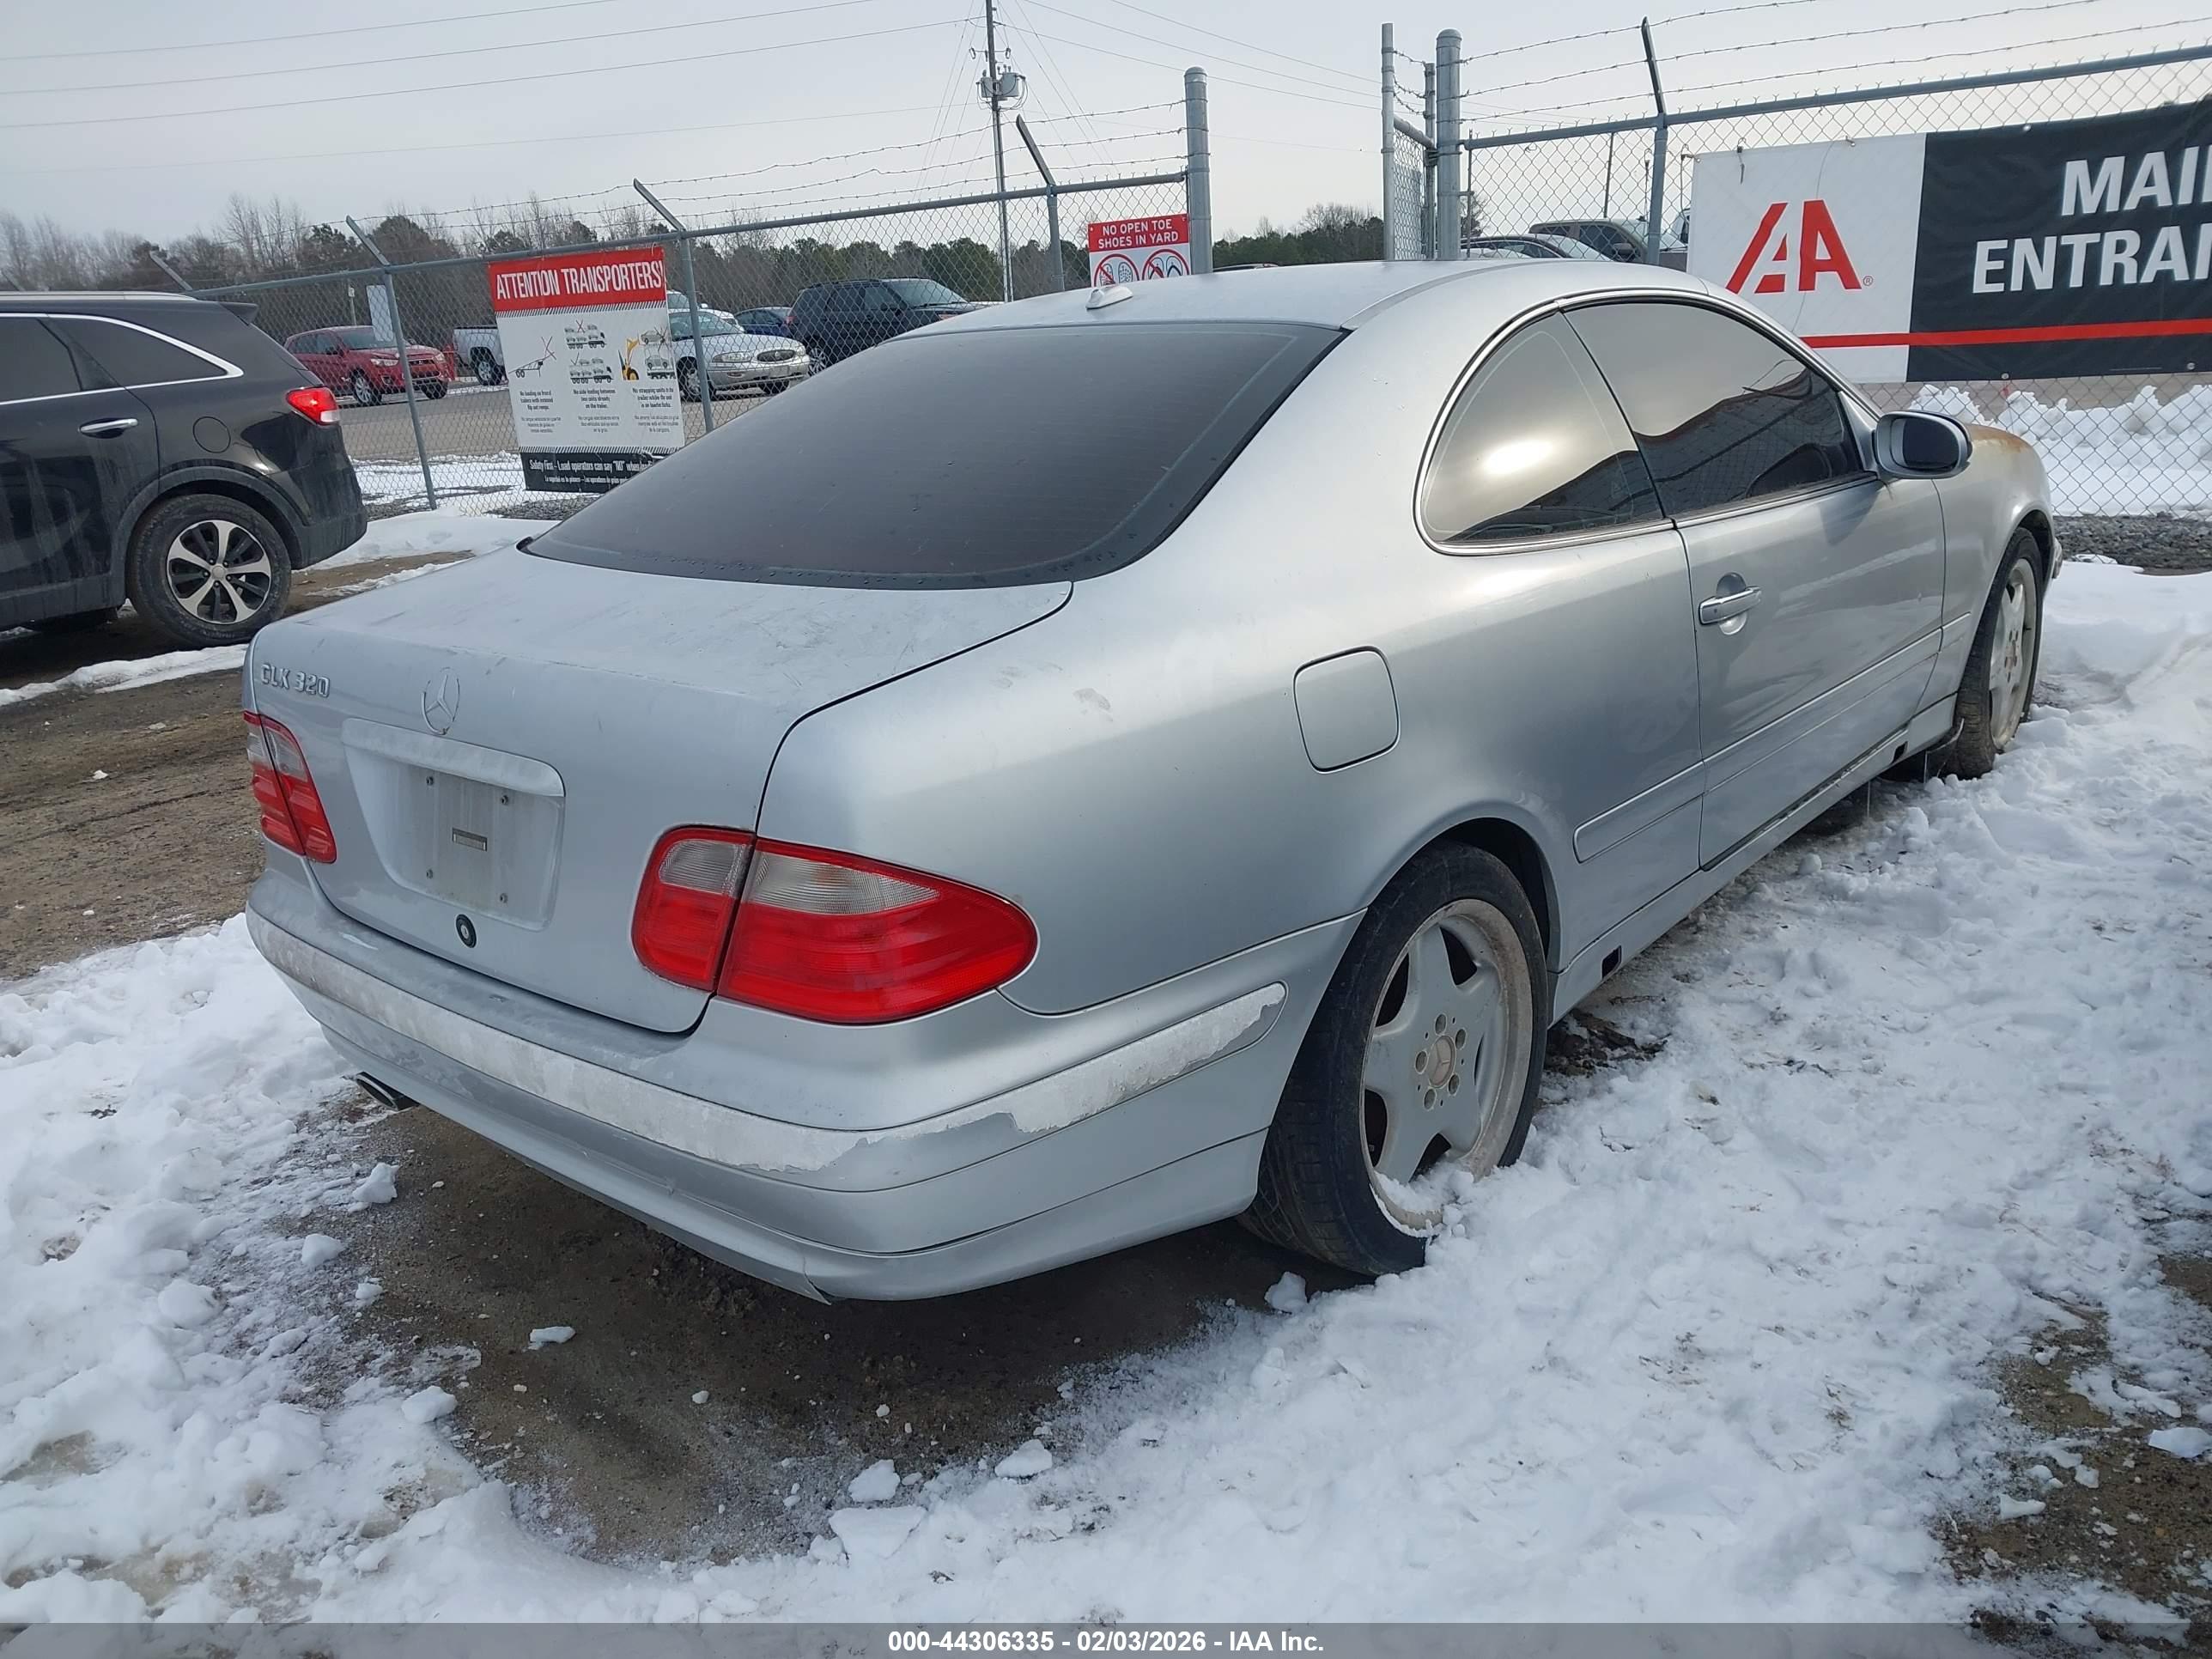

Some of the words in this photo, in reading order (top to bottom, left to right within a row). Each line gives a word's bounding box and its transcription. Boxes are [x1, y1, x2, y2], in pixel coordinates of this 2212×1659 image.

[2062, 144, 2212, 216] MAI
[1098, 236, 1133, 249] SHOES
[1135, 234, 1146, 245] IN
[1150, 231, 1179, 244] YARD
[1103, 225, 1117, 235] NO
[1120, 222, 1148, 234] OPEN
[1152, 219, 1172, 230] TOE
[496, 270, 560, 300] ATTENTION
[561, 260, 664, 295] TRANSPORTERS!
[261, 663, 289, 690] CLK
[295, 671, 330, 697] 320
